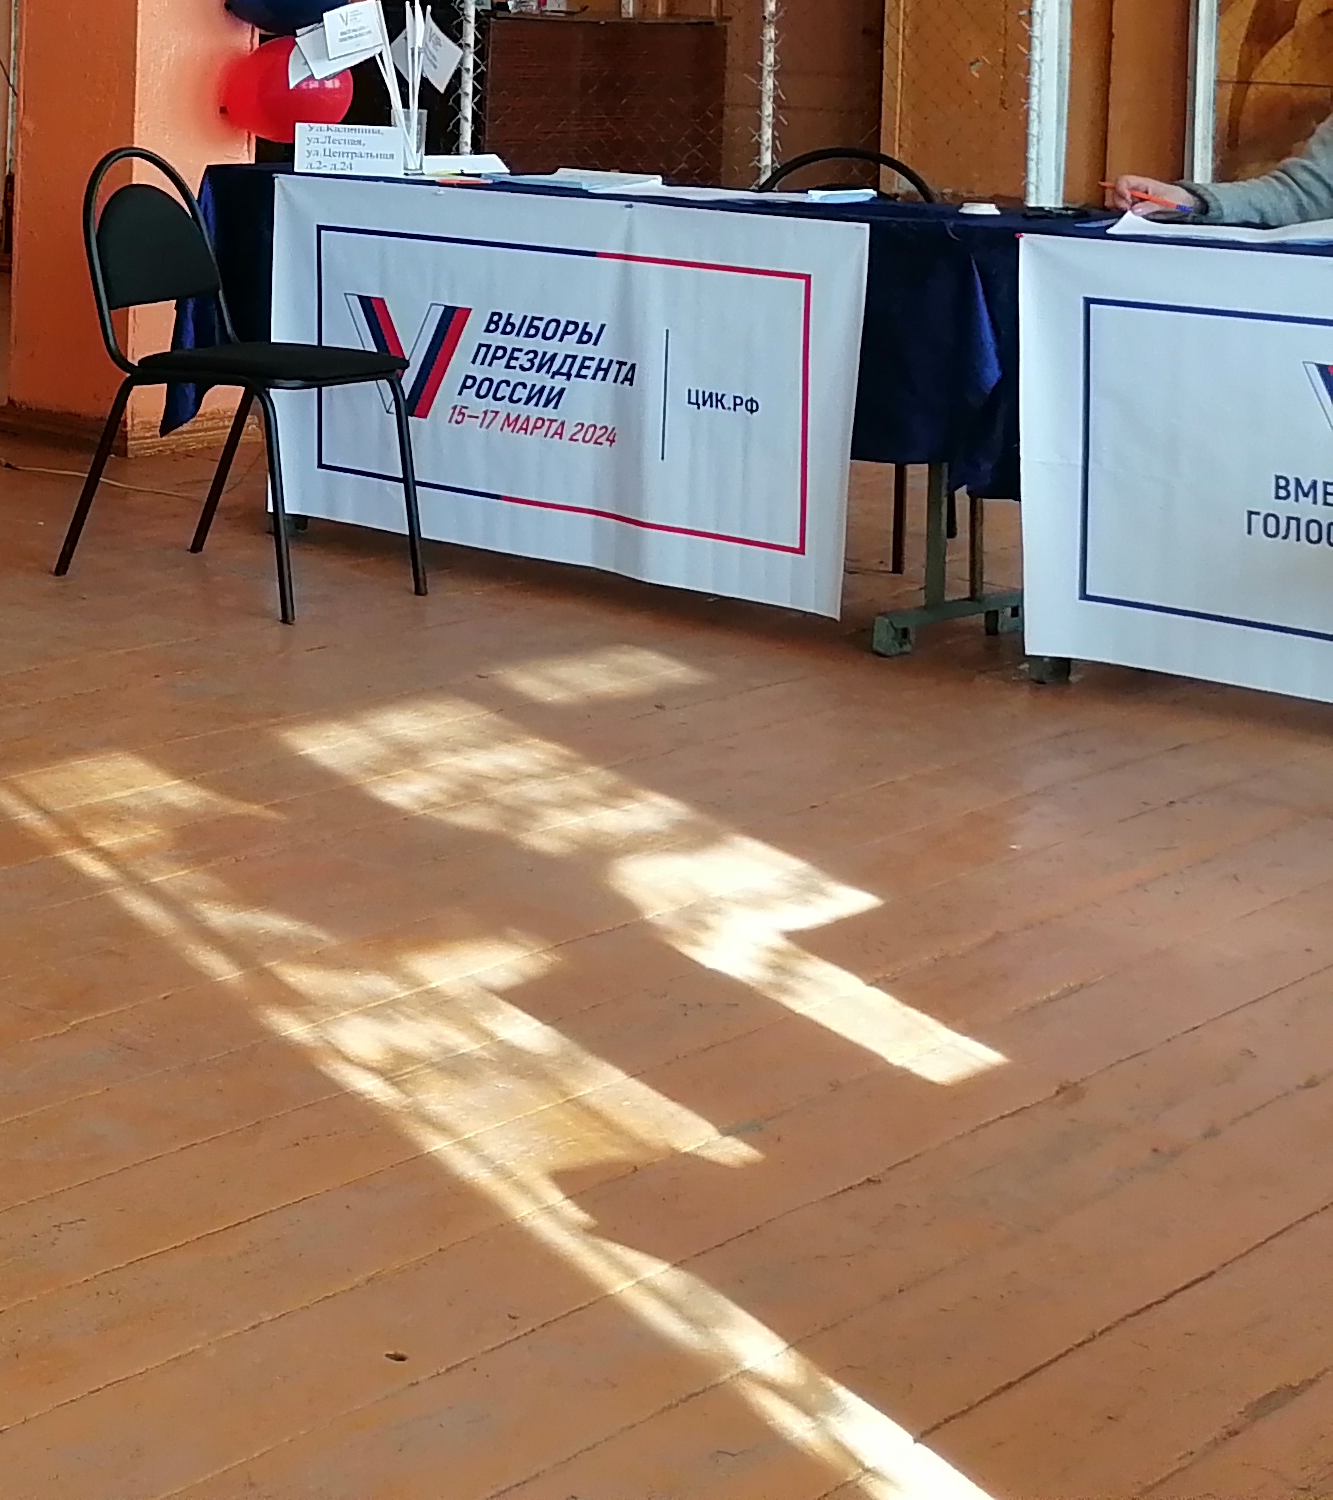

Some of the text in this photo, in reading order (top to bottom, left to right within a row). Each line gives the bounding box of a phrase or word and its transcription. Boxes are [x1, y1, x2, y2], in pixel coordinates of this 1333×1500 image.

[483, 311, 607, 346] ВЫБОРЫ
[470, 342, 637, 387] ПРЕЗИДЕНТА
[457, 374, 566, 410] РОССИИ
[687, 388, 760, 415] ЦИК.РФ
[499, 412, 566, 440] МАРТА
[568, 422, 618, 447] 2024
